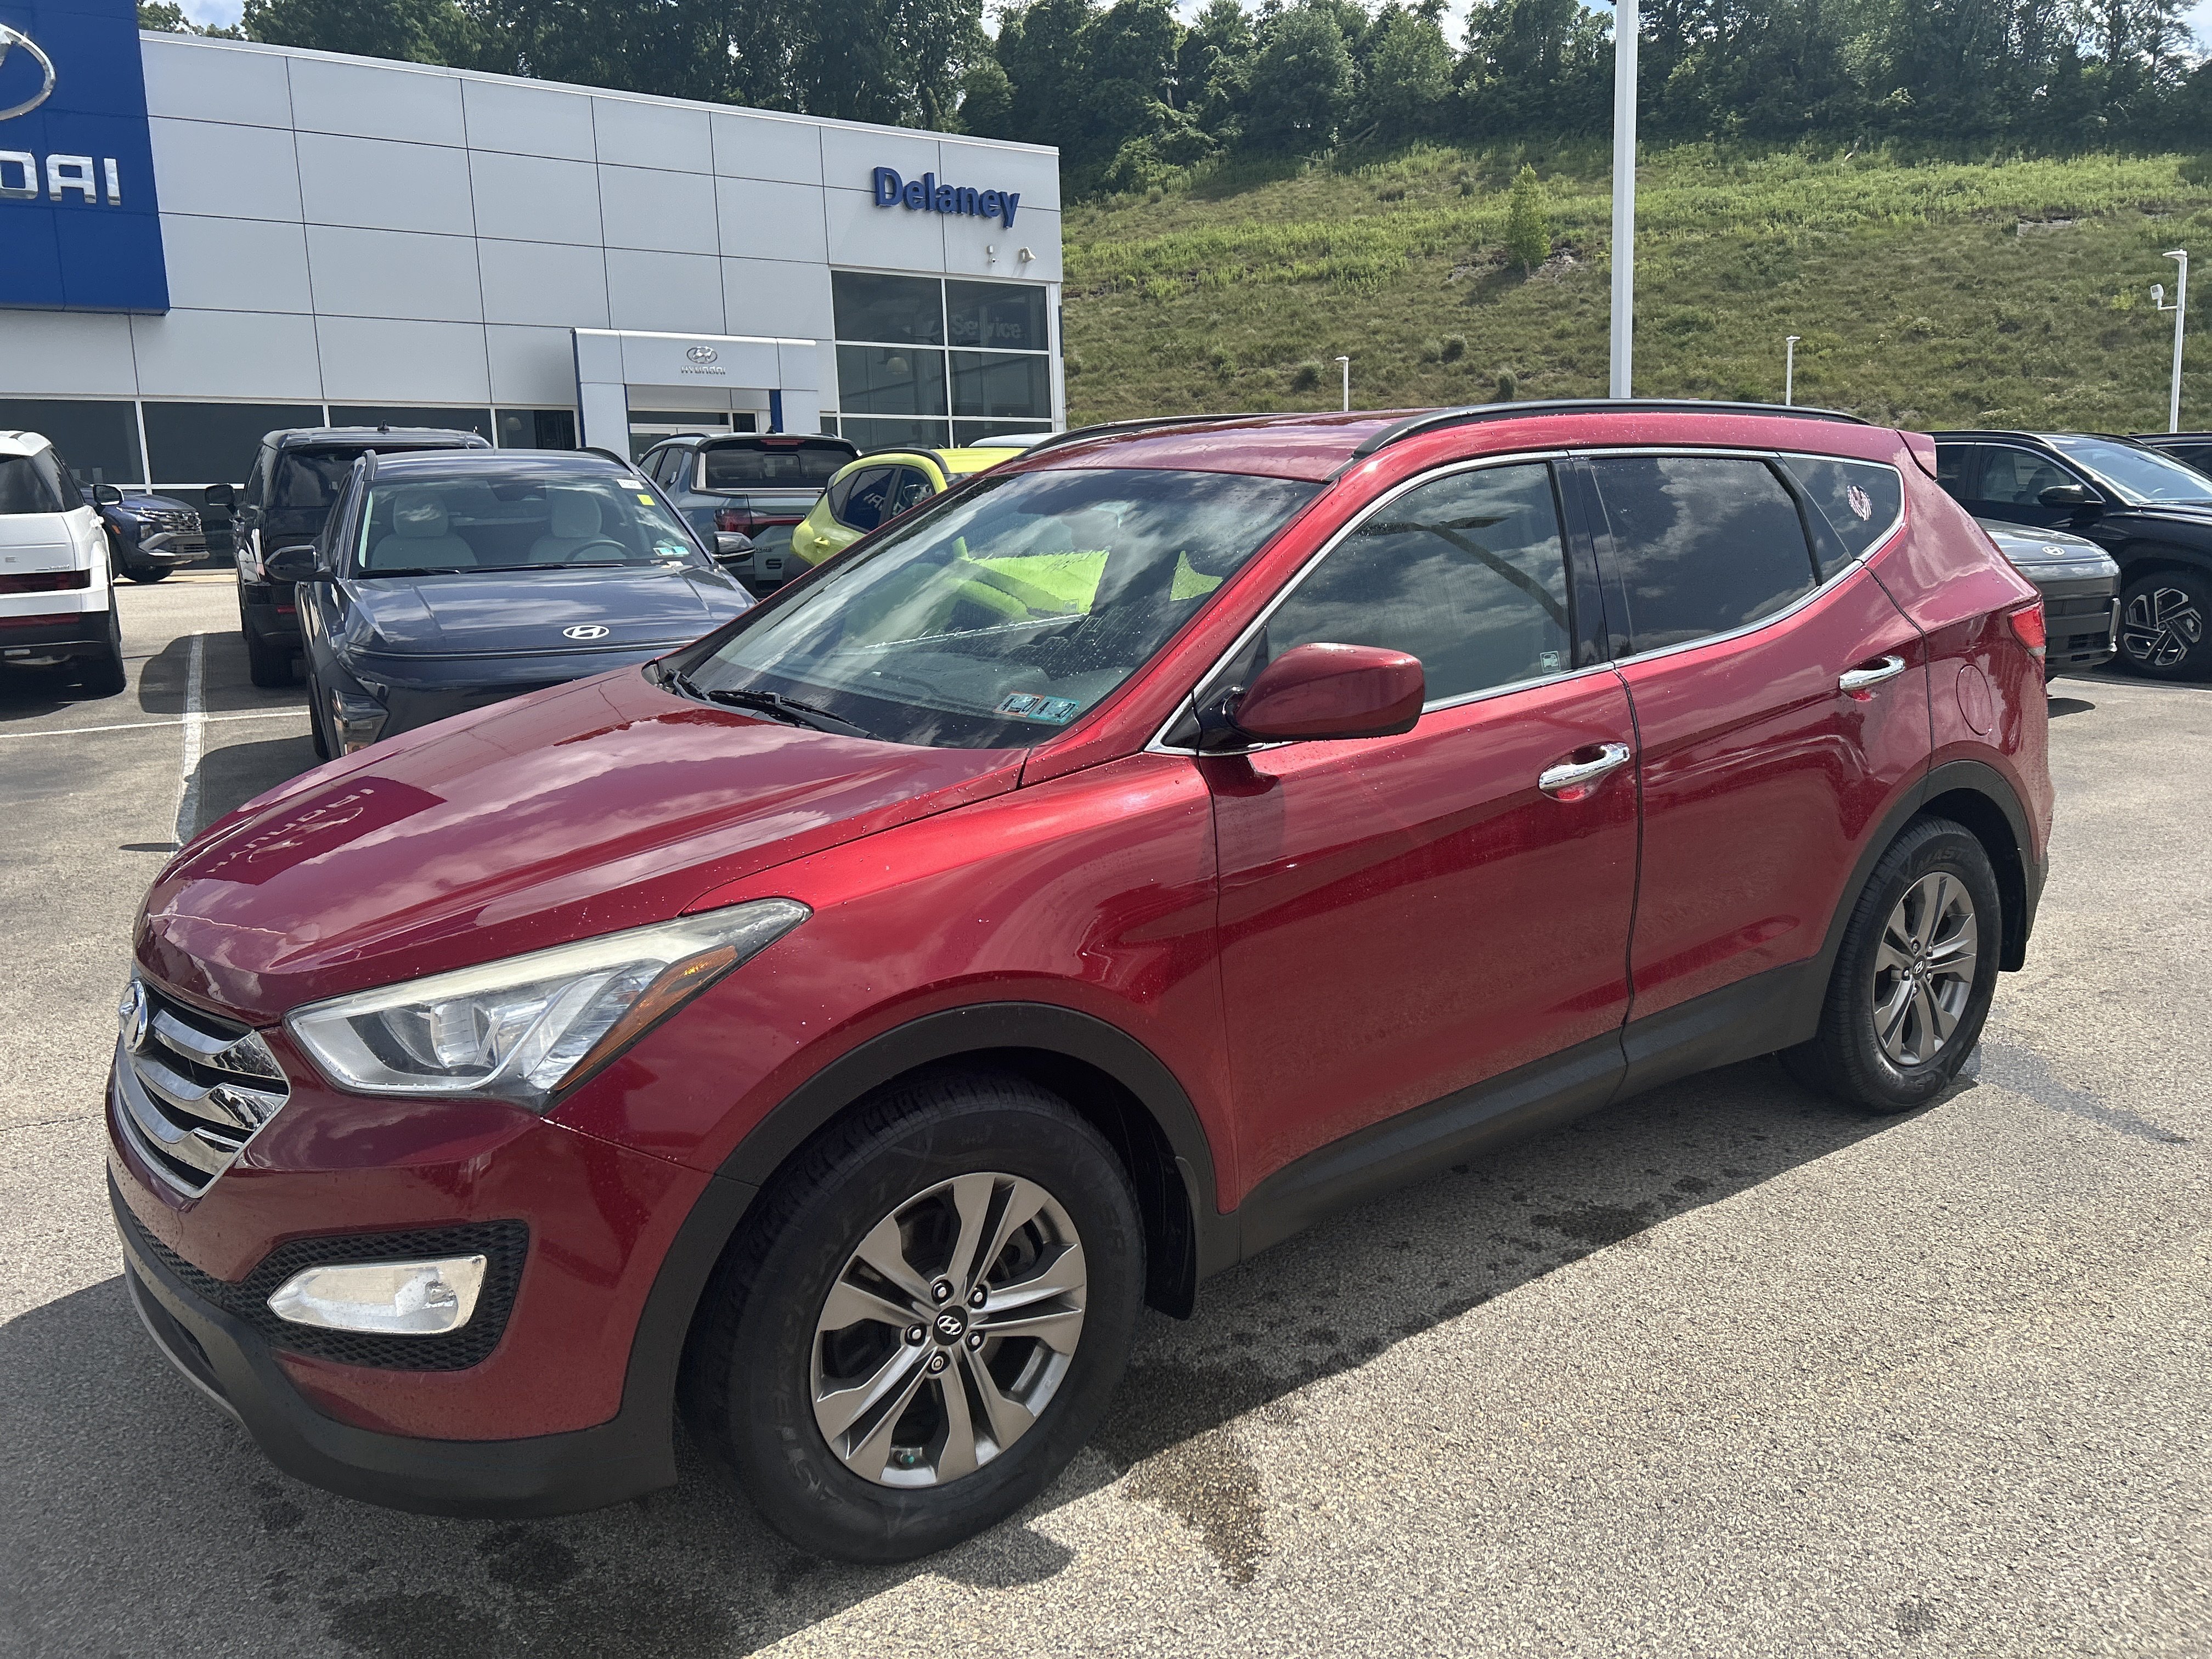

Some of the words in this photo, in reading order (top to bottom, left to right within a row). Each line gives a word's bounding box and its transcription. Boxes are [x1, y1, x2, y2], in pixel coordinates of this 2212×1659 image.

[873, 166, 1020, 228] Delaney
[950, 314, 1022, 338] Sevice
[680, 365, 726, 375] HYUNDAI
